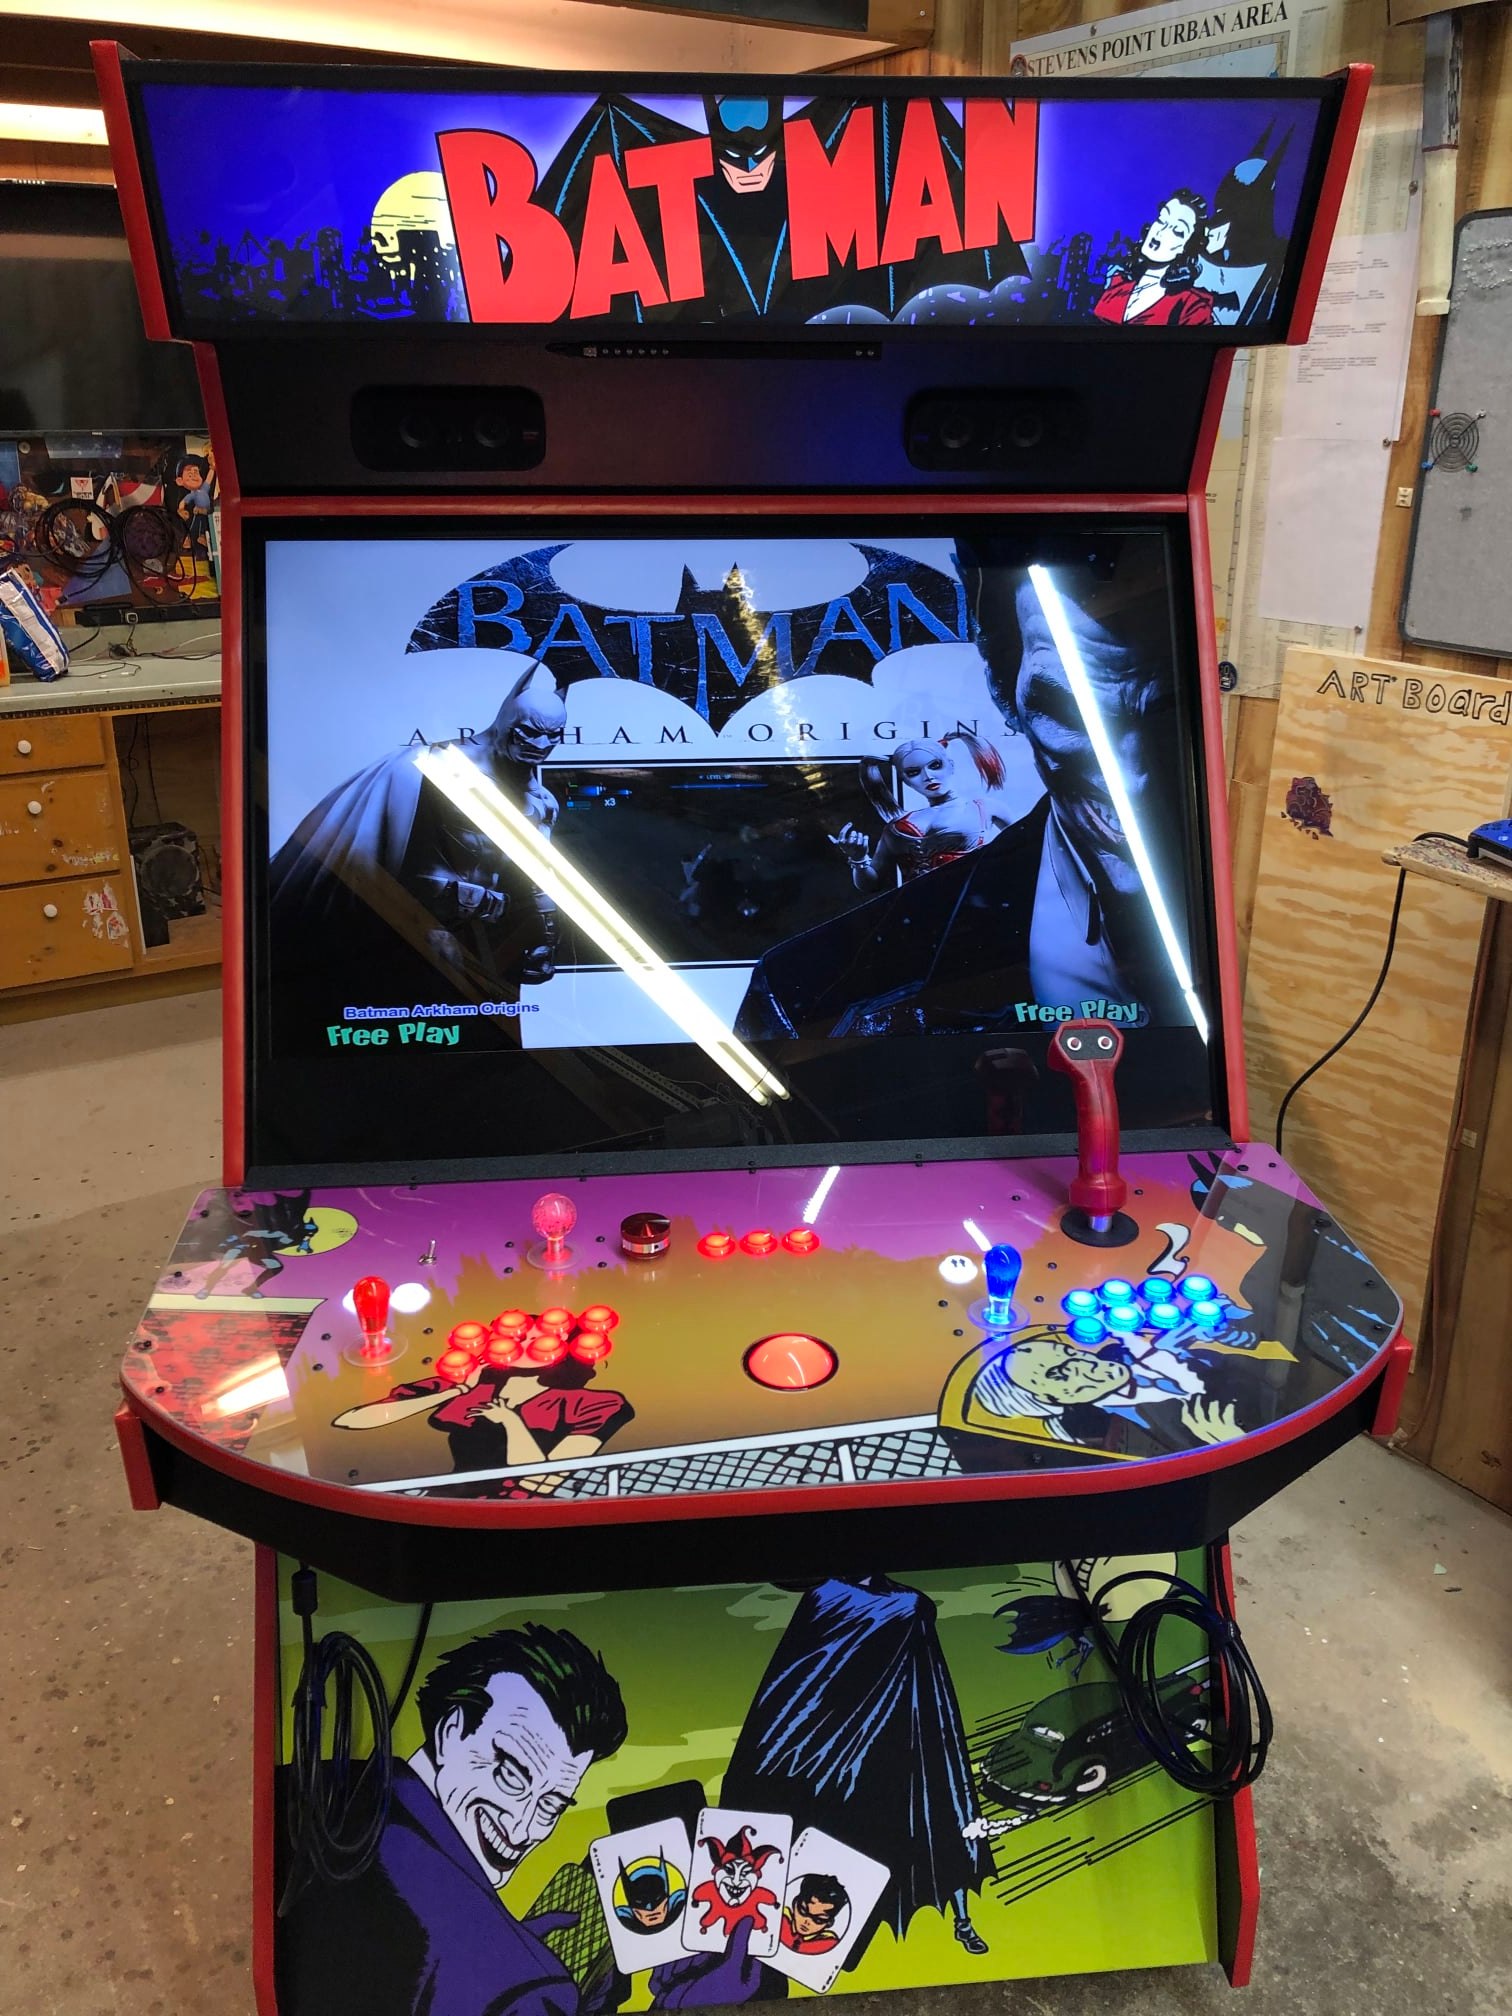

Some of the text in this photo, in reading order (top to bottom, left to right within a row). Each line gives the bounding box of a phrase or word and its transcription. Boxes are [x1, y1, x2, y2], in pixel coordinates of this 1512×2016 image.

[1027, 0, 1289, 77] STEVENS POINT URBAN AREA
[457, 579, 969, 721] BATMAN
[1317, 669, 1391, 704] ART
[401, 725, 693, 747] ARHAM
[604, 798, 616, 807] x3
[344, 1002, 540, 1020] Batman Arkham Origins
[1014, 999, 1138, 1023] Free Play
[327, 1021, 460, 1047] Free Play
